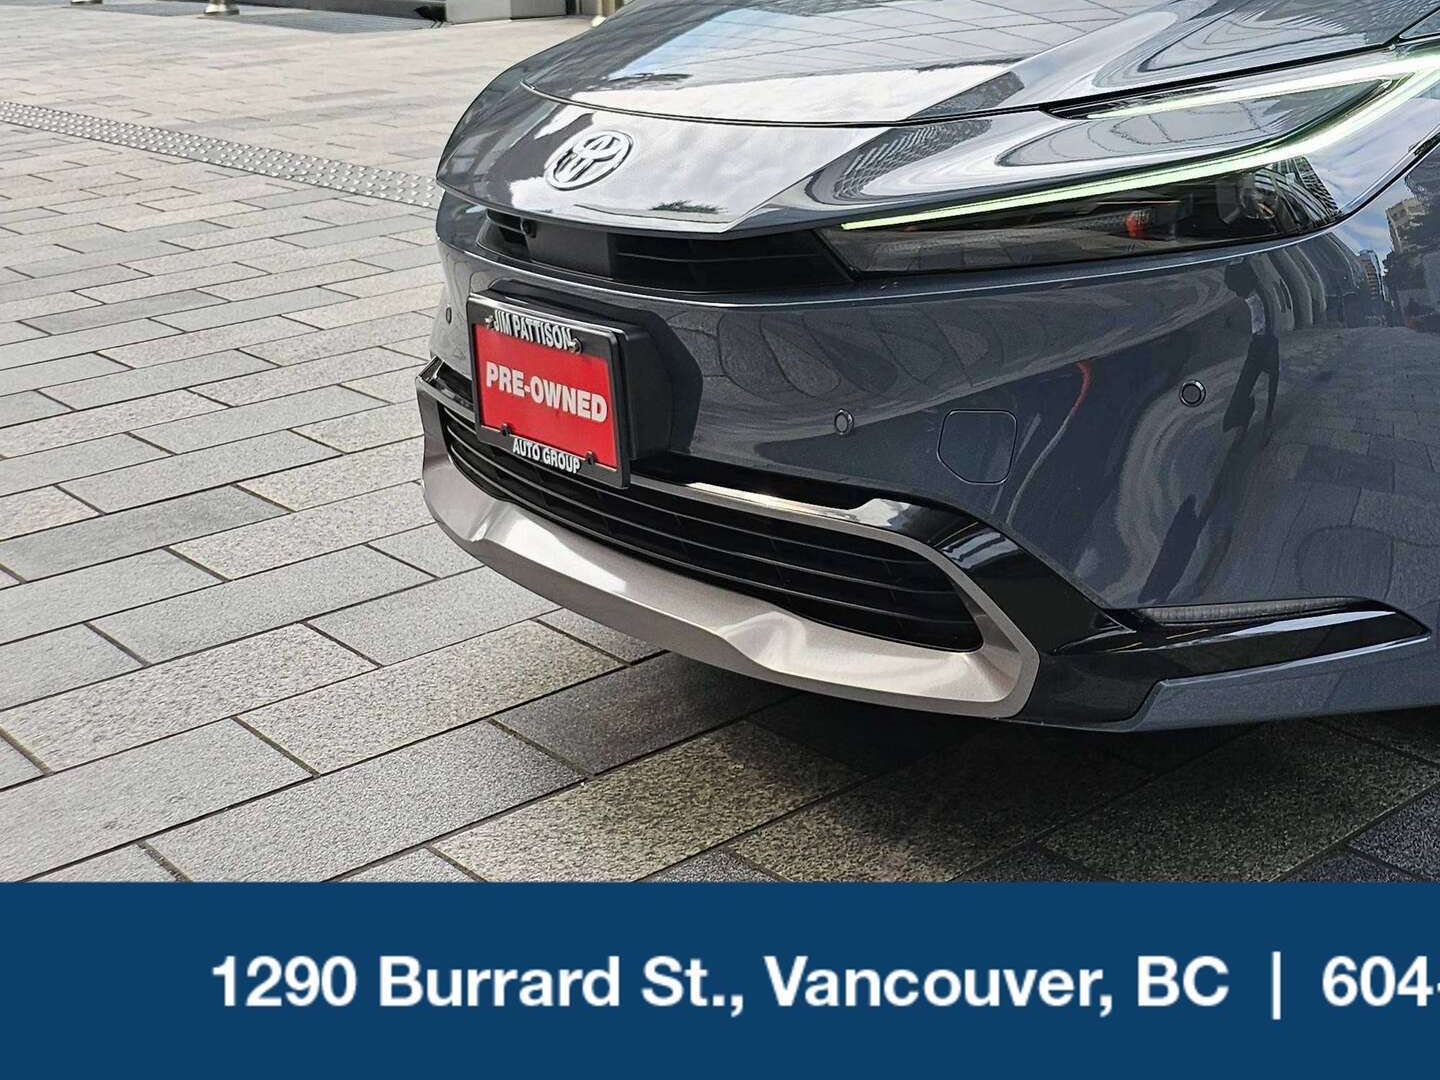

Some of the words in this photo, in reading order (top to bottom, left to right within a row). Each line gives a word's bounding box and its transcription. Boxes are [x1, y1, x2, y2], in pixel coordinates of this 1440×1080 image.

[493, 309, 512, 335] JIM
[512, 315, 575, 351] PATTISON
[485, 360, 609, 424] PRE-OWNED
[511, 438, 541, 463] AUTO
[542, 444, 583, 475] GROUP
